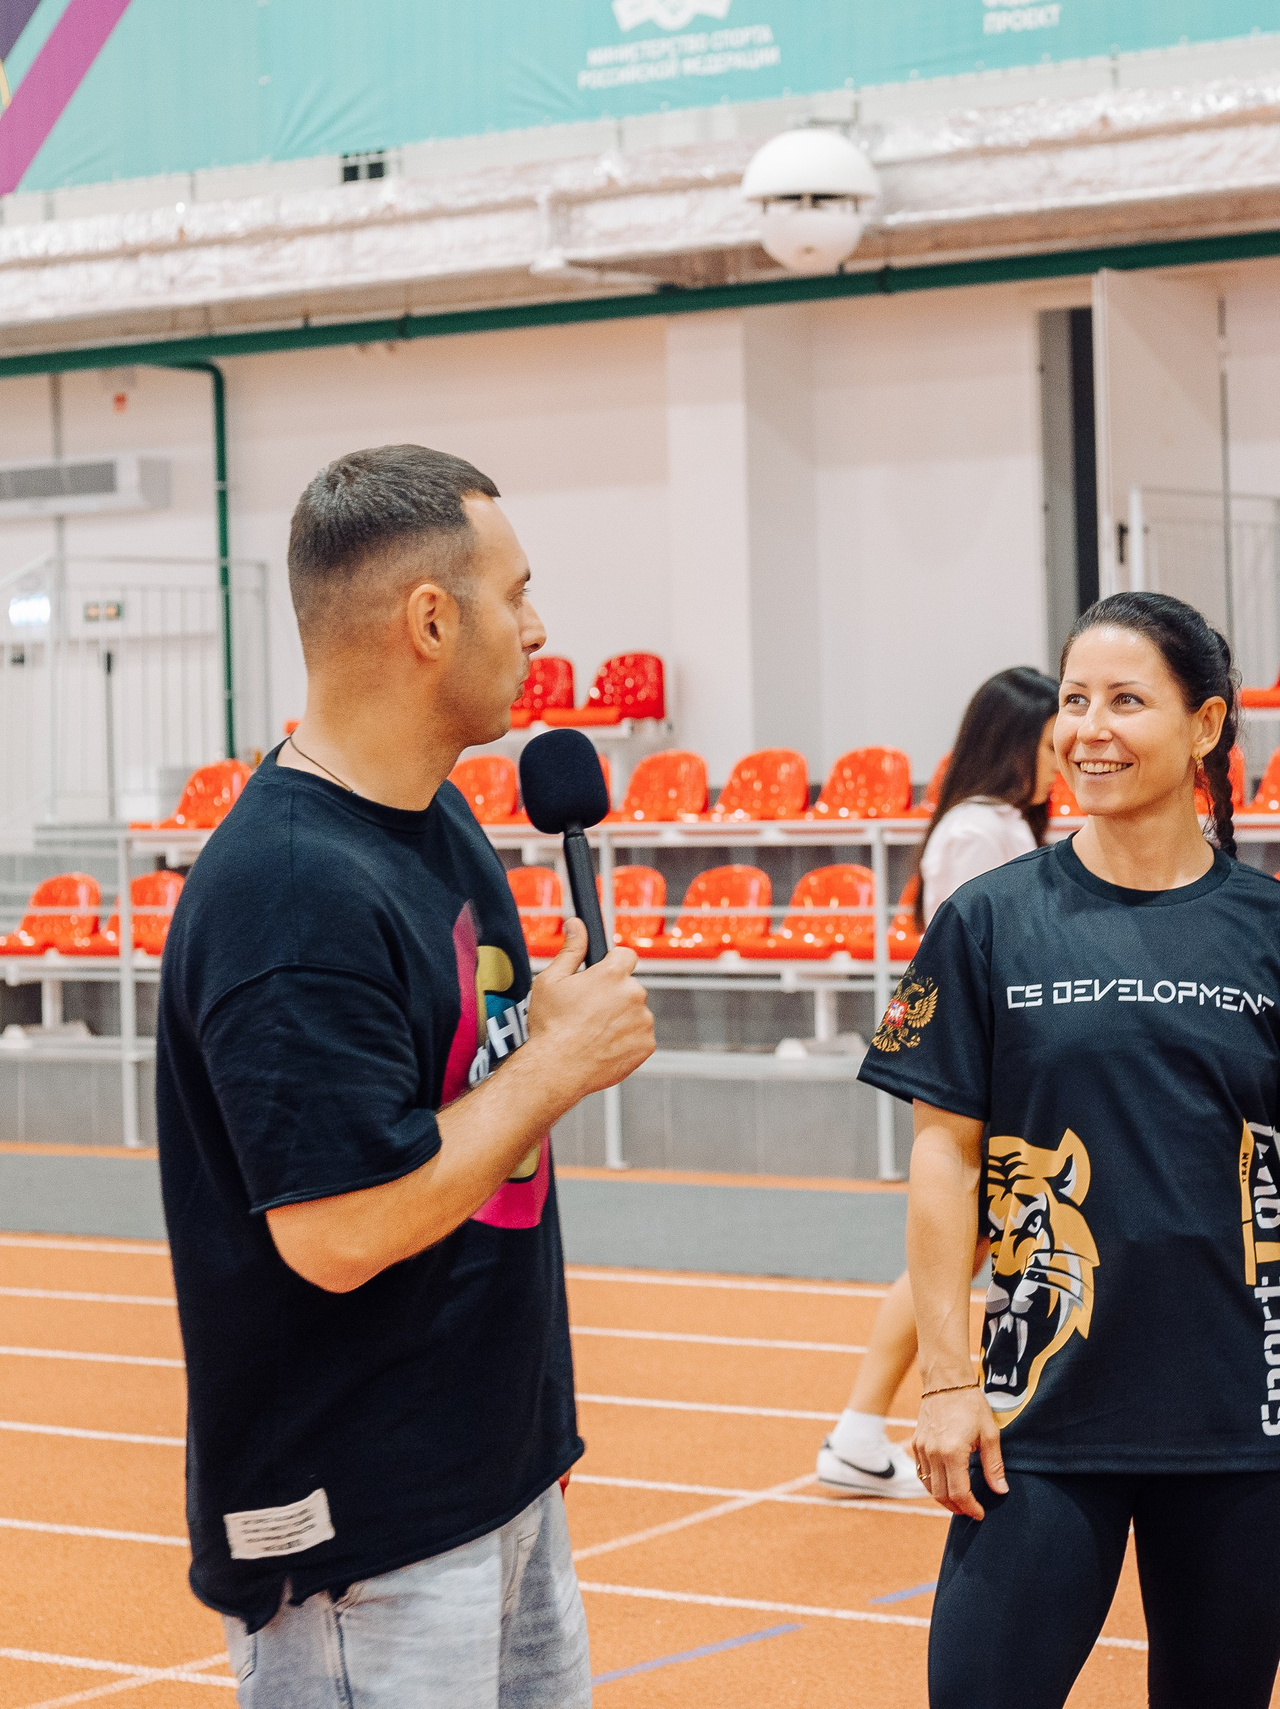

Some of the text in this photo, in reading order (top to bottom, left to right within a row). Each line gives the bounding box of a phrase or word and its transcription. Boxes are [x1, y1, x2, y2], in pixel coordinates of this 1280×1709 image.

[983, 3, 1062, 35] ПРОЕКТ
[586, 24, 775, 67] МИНИСТЕРСТВО СПОРТА
[1006, 978, 1275, 1015] CS DEVELOPMENT
[1241, 1151, 1250, 1183] TEAM
